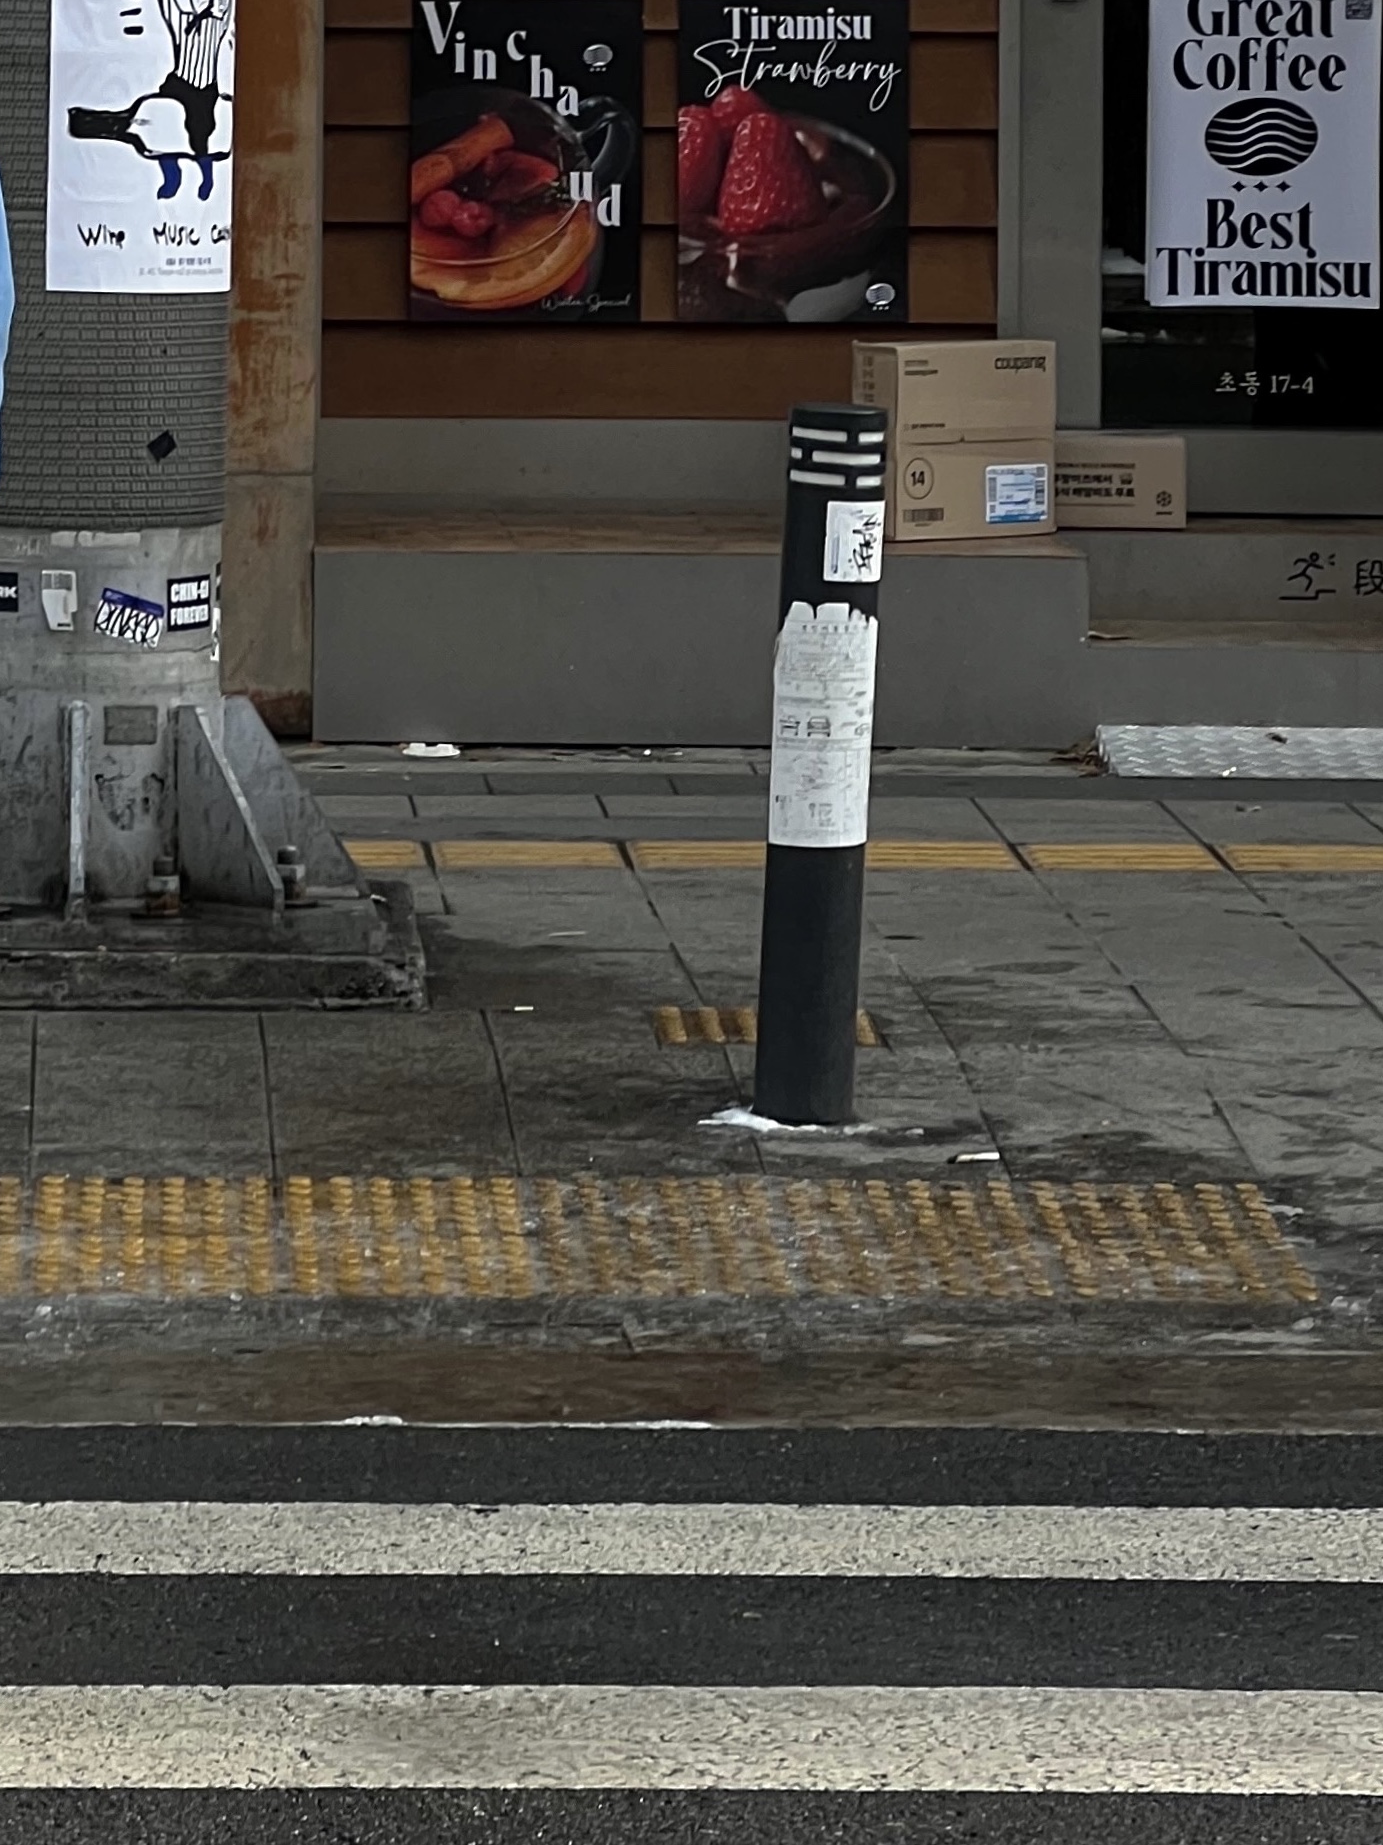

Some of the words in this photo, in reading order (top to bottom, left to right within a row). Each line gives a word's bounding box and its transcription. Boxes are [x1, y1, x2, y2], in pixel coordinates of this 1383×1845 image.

[723, 6, 872, 41] Tiramisu
[693, 38, 902, 112] Strawberry
[1172, 37, 1347, 92] Coffee
[1205, 198, 1317, 251] Best
[1156, 247, 1372, 298] Tiramisu
[1215, 371, 1261, 396] 초동
[1269, 374, 1315, 395] 17-4
[911, 470, 926, 487] 14
